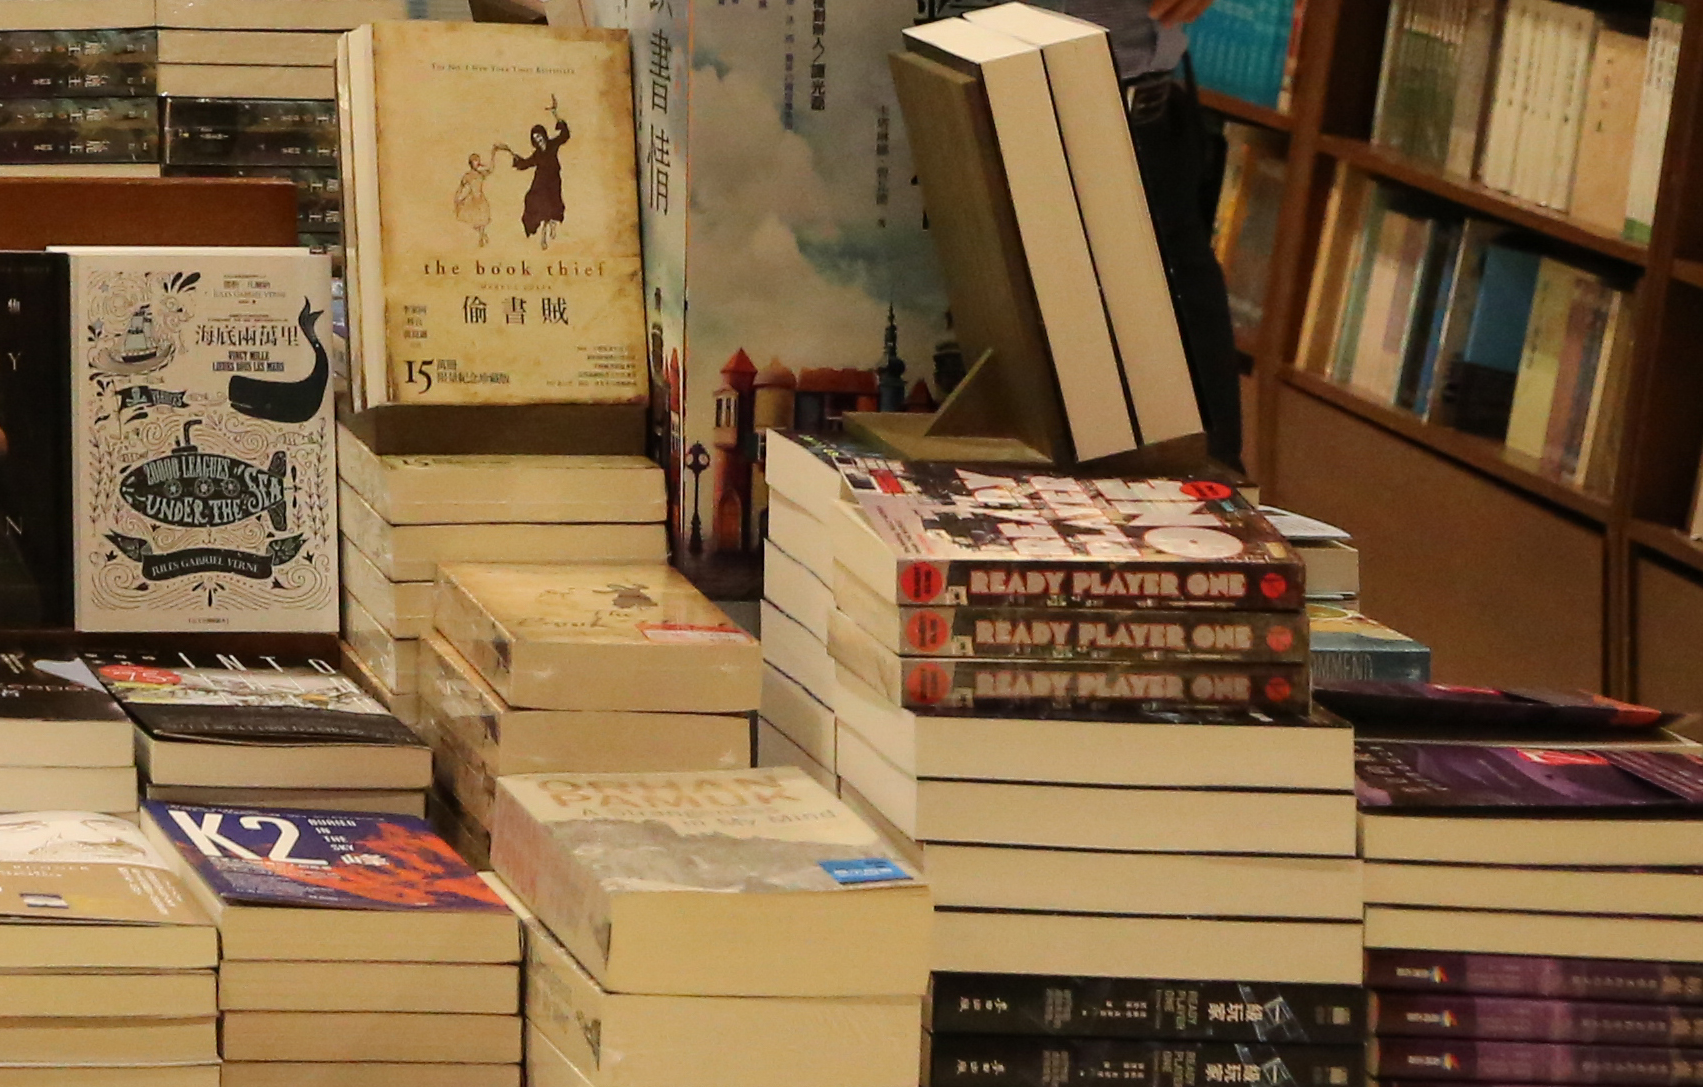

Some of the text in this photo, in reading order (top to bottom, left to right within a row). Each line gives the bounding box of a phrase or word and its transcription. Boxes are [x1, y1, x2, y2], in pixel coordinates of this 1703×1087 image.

[424, 259, 607, 277] the book thief
[462, 295, 570, 326] 偷書賊
[404, 359, 435, 394] 15
[181, 455, 231, 479] LEAGUES
[146, 466, 283, 524] UNDER THE SEA
[151, 561, 180, 577] JULES
[180, 556, 224, 568] GABRIEL
[969, 569, 1248, 599] READY PLAYER ONE
[975, 620, 1253, 650] READY PLAYER ONE
[975, 669, 1252, 702] READY PLAYER ONE
[536, 774, 783, 793] ORHAN
[548, 787, 802, 809] PAMUK
[167, 809, 330, 866] K2
[316, 827, 331, 835] IN
[323, 835, 349, 843] THE
[330, 844, 355, 852] SKY
